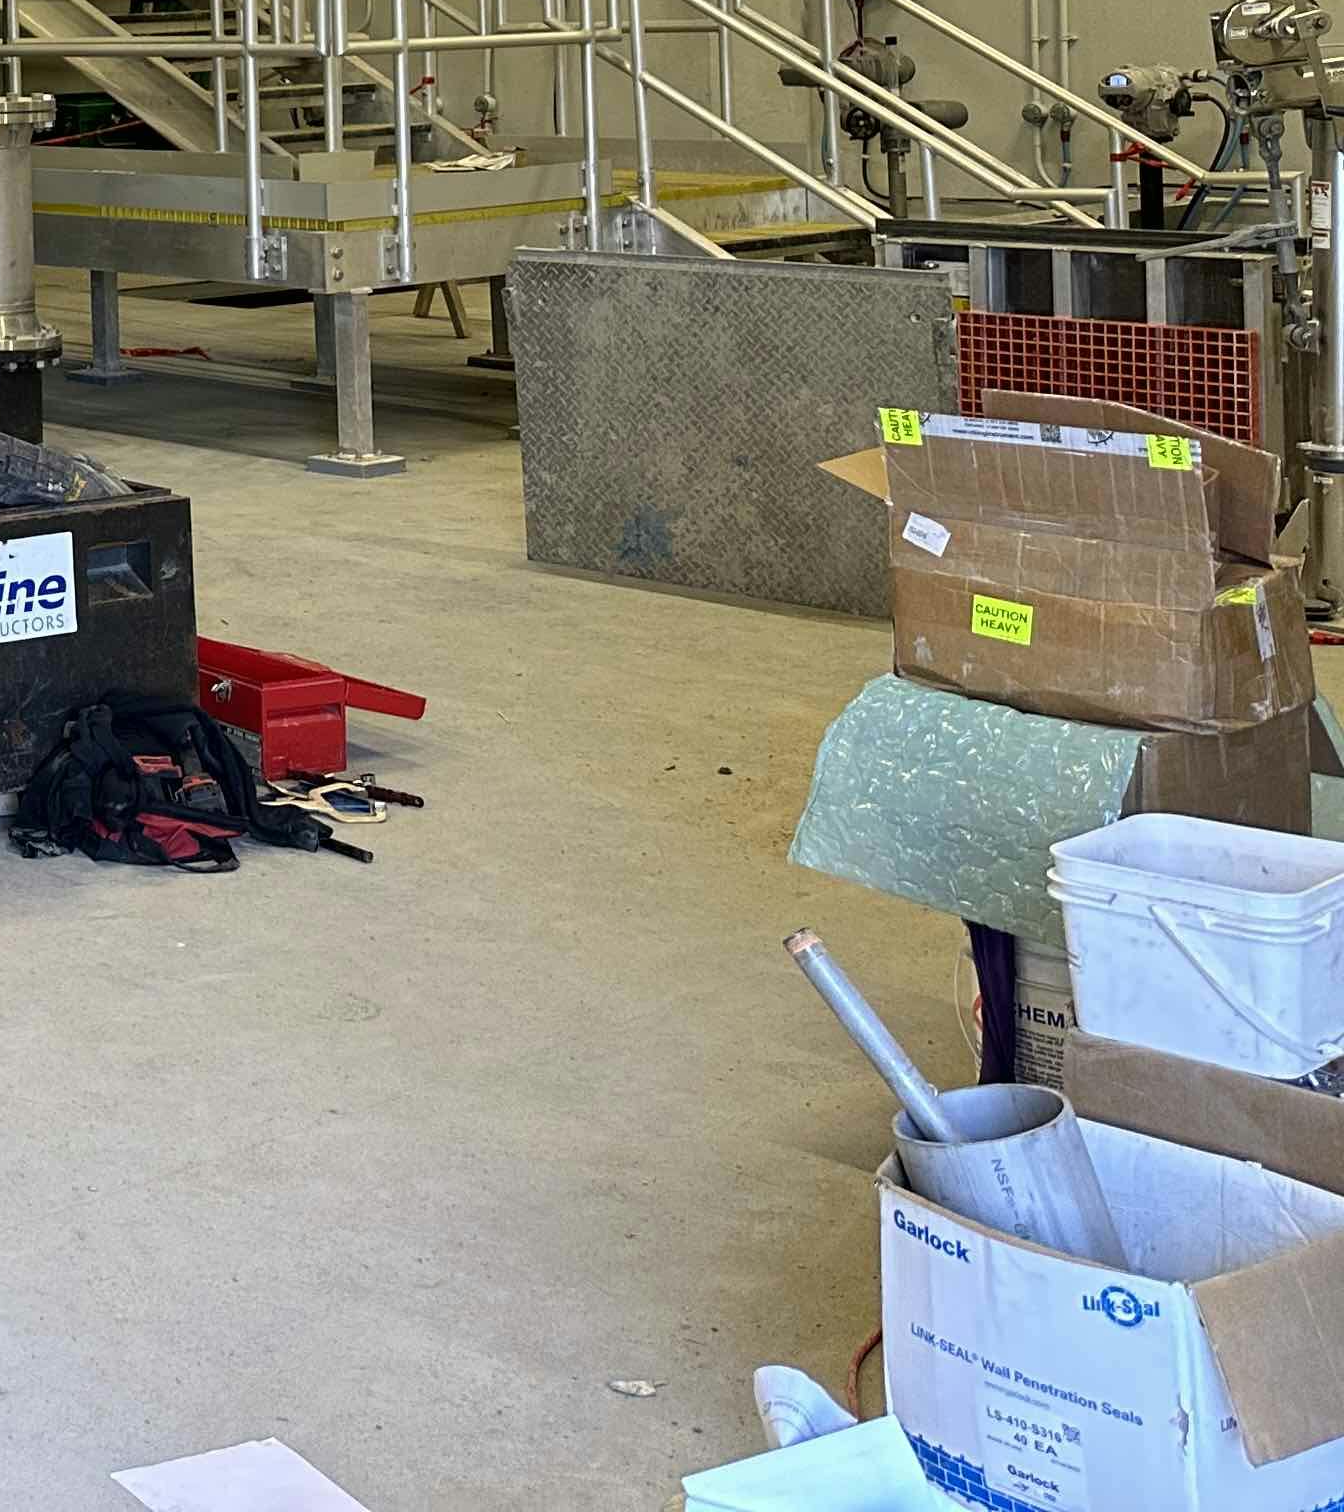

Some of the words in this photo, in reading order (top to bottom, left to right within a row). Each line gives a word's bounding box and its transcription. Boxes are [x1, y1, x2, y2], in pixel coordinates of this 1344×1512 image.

[975, 603, 1028, 624] CAUTION
[980, 618, 1020, 635] HEAVY
[1012, 1000, 1065, 1029] HEM
[894, 1208, 971, 1264] Garlock
[980, 1356, 1011, 1380] Wall
[1014, 1369, 1098, 1412] Penetration
[1100, 1401, 1144, 1427] Seals
[1013, 1432, 1028, 1446] 40
[1034, 1439, 1058, 1457] EA
[1007, 1463, 1060, 1494] Garlock
